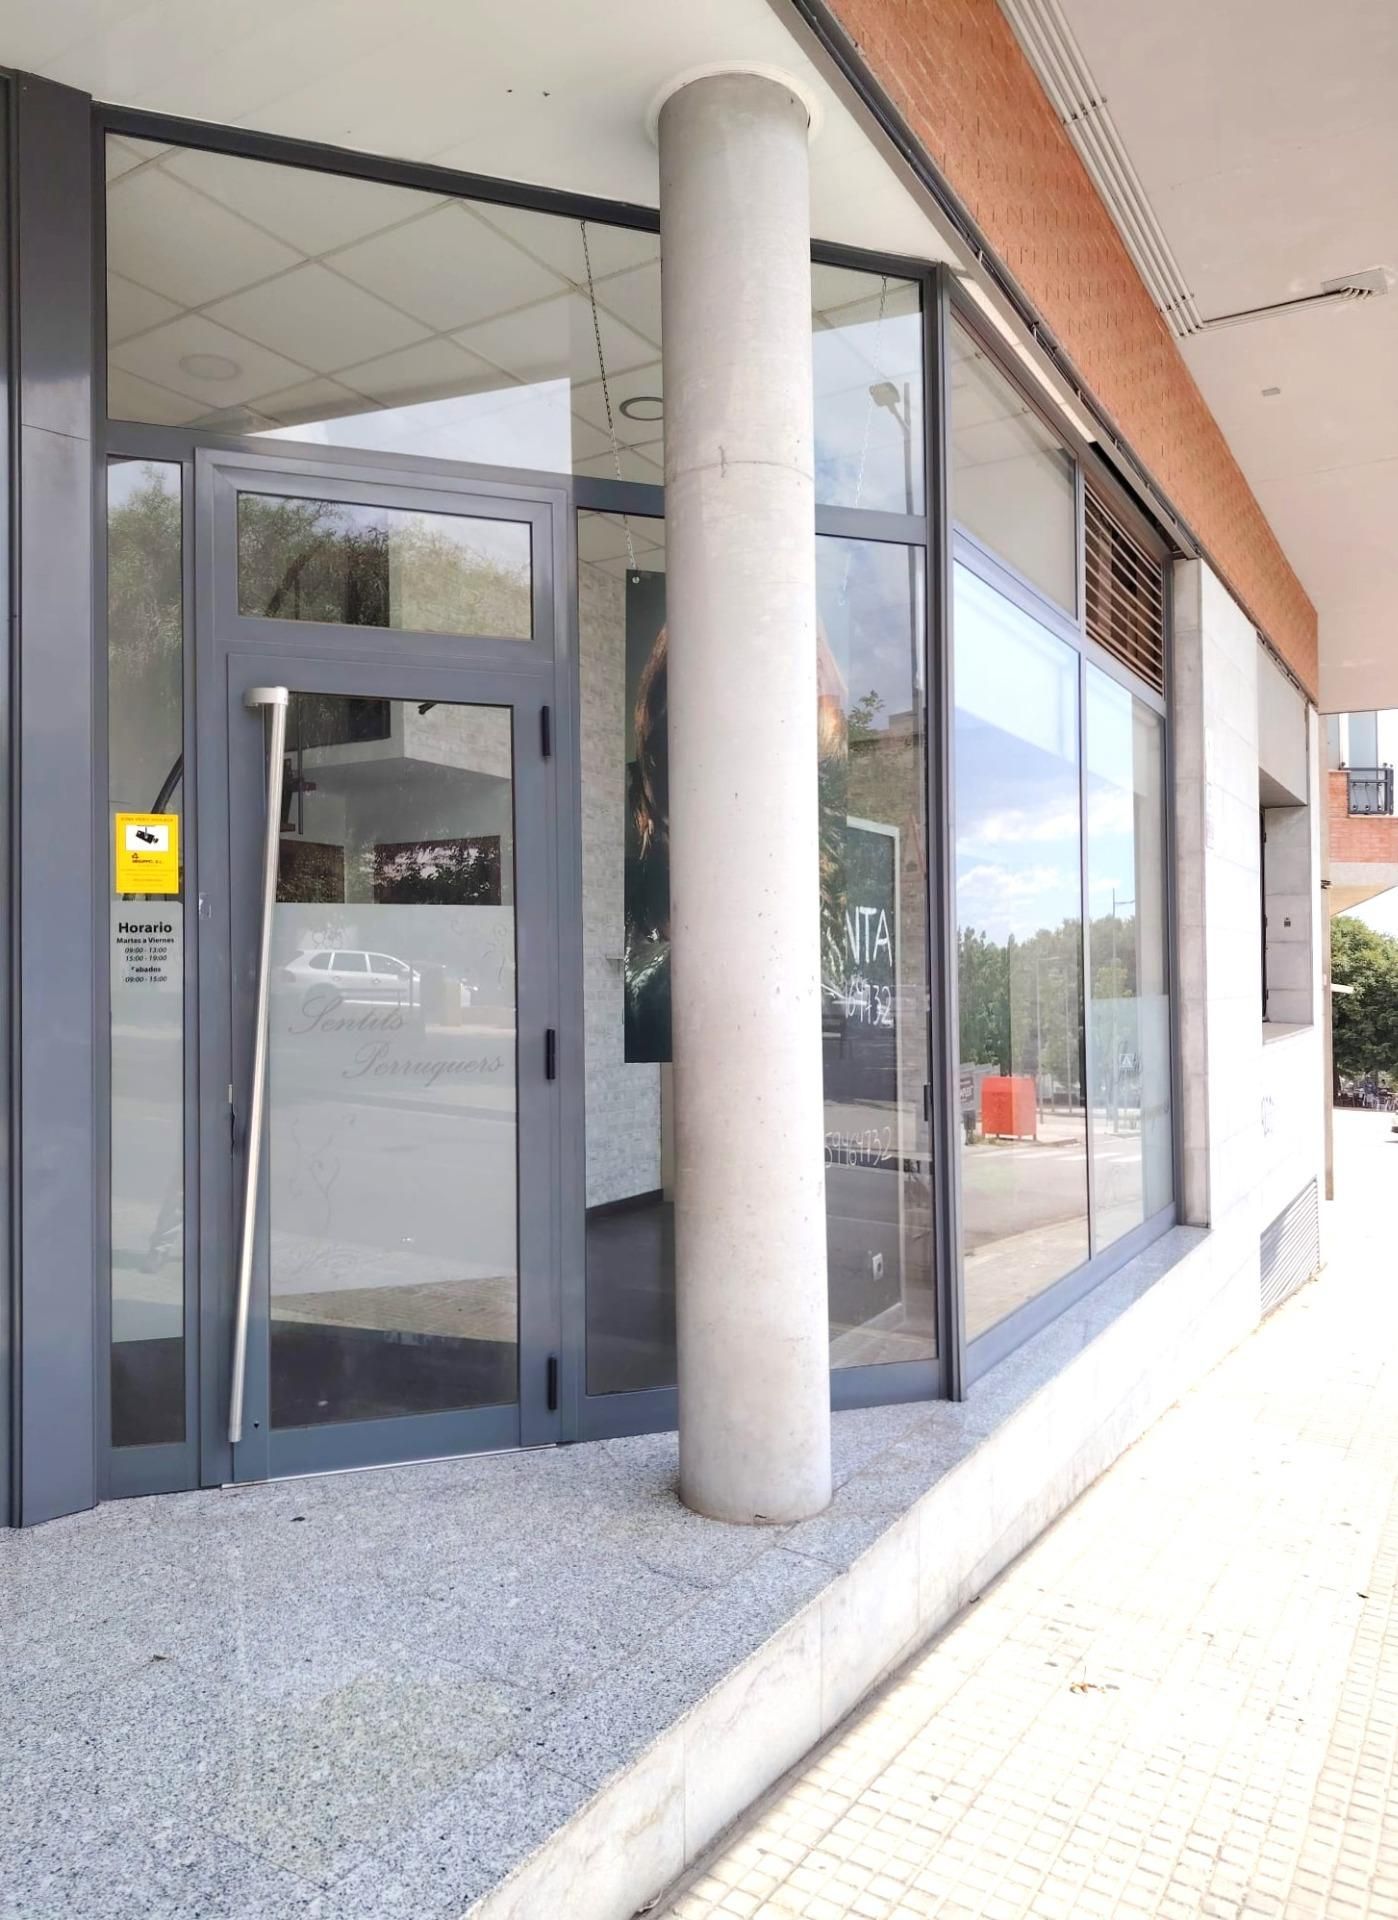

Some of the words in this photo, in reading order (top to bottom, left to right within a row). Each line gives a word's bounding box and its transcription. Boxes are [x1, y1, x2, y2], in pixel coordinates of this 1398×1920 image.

[118, 921, 172, 933] Horario
[845, 905, 893, 968] NTA
[287, 995, 408, 1035] Sentits
[341, 1040, 504, 1088] Perruquers
